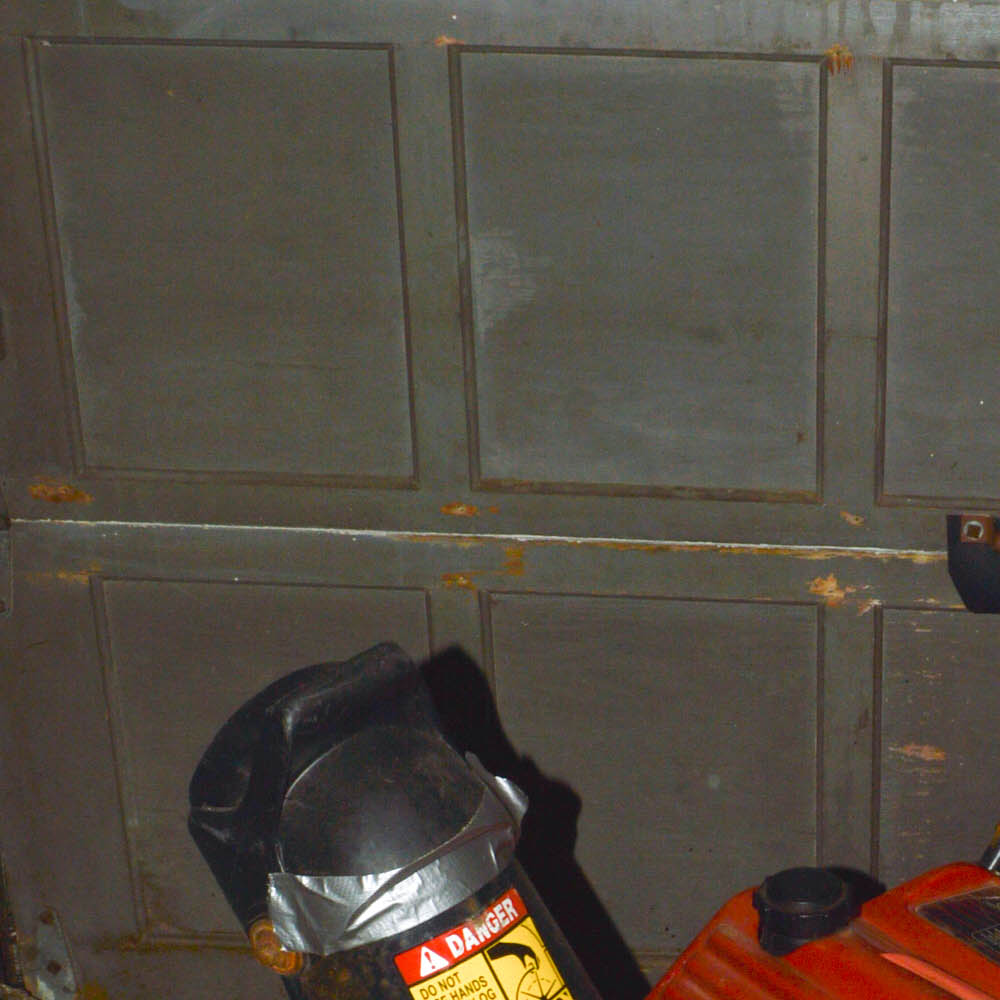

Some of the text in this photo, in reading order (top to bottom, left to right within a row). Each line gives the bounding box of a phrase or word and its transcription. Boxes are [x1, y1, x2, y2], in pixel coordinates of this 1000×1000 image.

[445, 897, 519, 959] DANGER
[420, 972, 461, 1000] DO NOT
